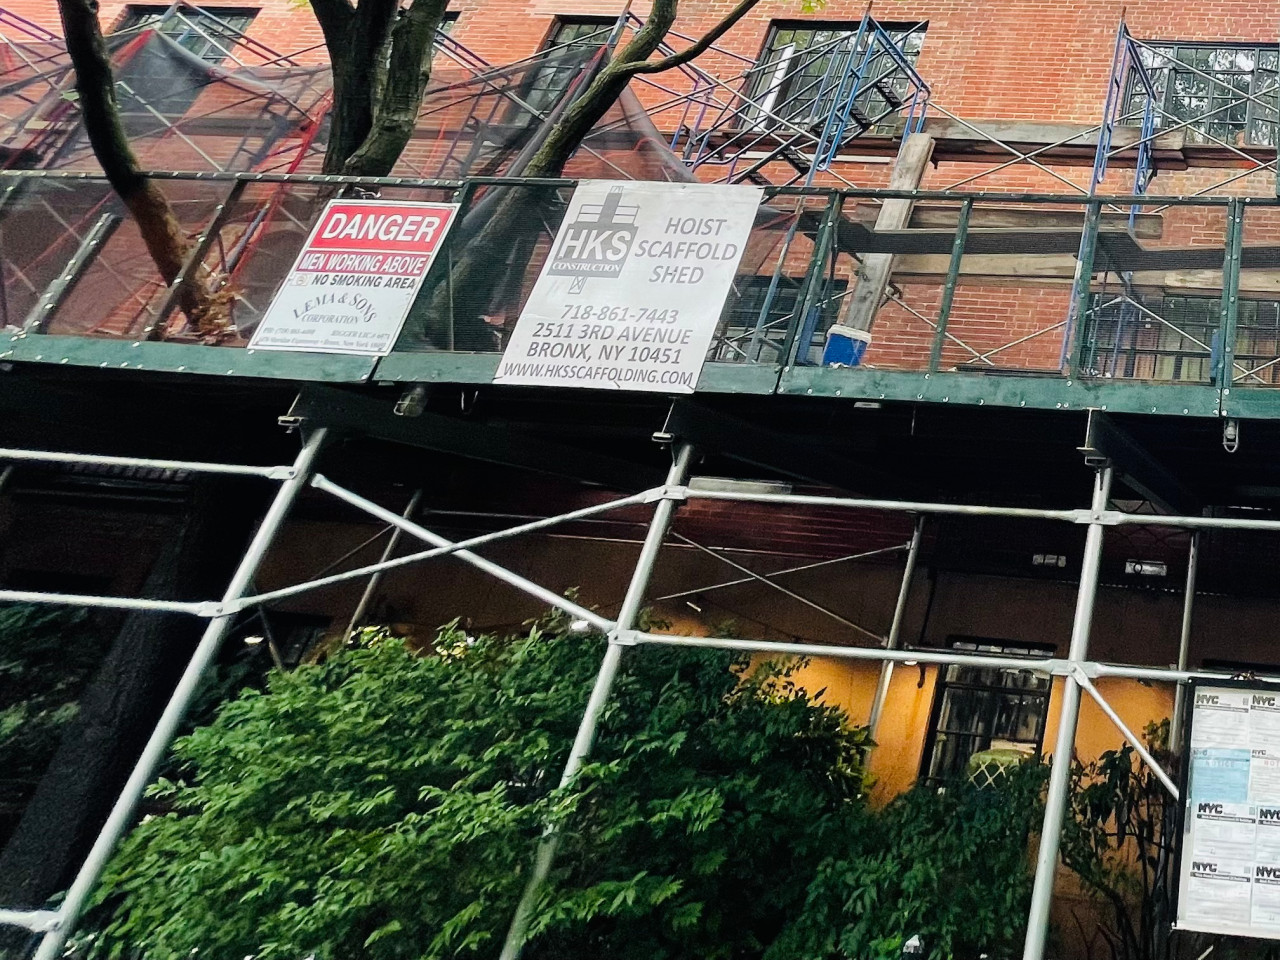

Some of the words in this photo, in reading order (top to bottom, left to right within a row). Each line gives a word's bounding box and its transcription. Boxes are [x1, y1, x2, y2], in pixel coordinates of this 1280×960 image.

[322, 213, 440, 243] DANGER
[664, 217, 727, 236] HOIST
[561, 229, 631, 261] HKS
[635, 240, 738, 261] SCAFFOLD
[299, 253, 324, 271] MEN
[326, 254, 383, 272] WORKING
[381, 256, 427, 274] ABOVE
[552, 262, 621, 272] CONSTRUCTION
[312, 274, 329, 285] NO
[330, 275, 384, 287] SMOKING
[384, 277, 416, 290] AREA
[649, 265, 704, 284] SHED
[293, 293, 334, 318] LEMA
[337, 293, 348, 304] &
[348, 293, 377, 322] SONS
[560, 305, 679, 324] 718-861-7443
[301, 314, 358, 324] CORPORATION
[532, 323, 574, 338] 2511
[578, 325, 615, 340] 3RD
[617, 327, 693, 345] AVENUE
[526, 342, 591, 362] BRONX,
[598, 345, 626, 361] NY
[628, 346, 681, 364] 10451
[503, 362, 694, 385] WWW.HKSSCAFFOLDING.COM
[1196, 694, 1219, 705] NYC
[1252, 695, 1275, 706] NYC
[1198, 803, 1223, 814] NYC
[1192, 861, 1217, 872] NYC
[1256, 866, 1280, 878] NYC
